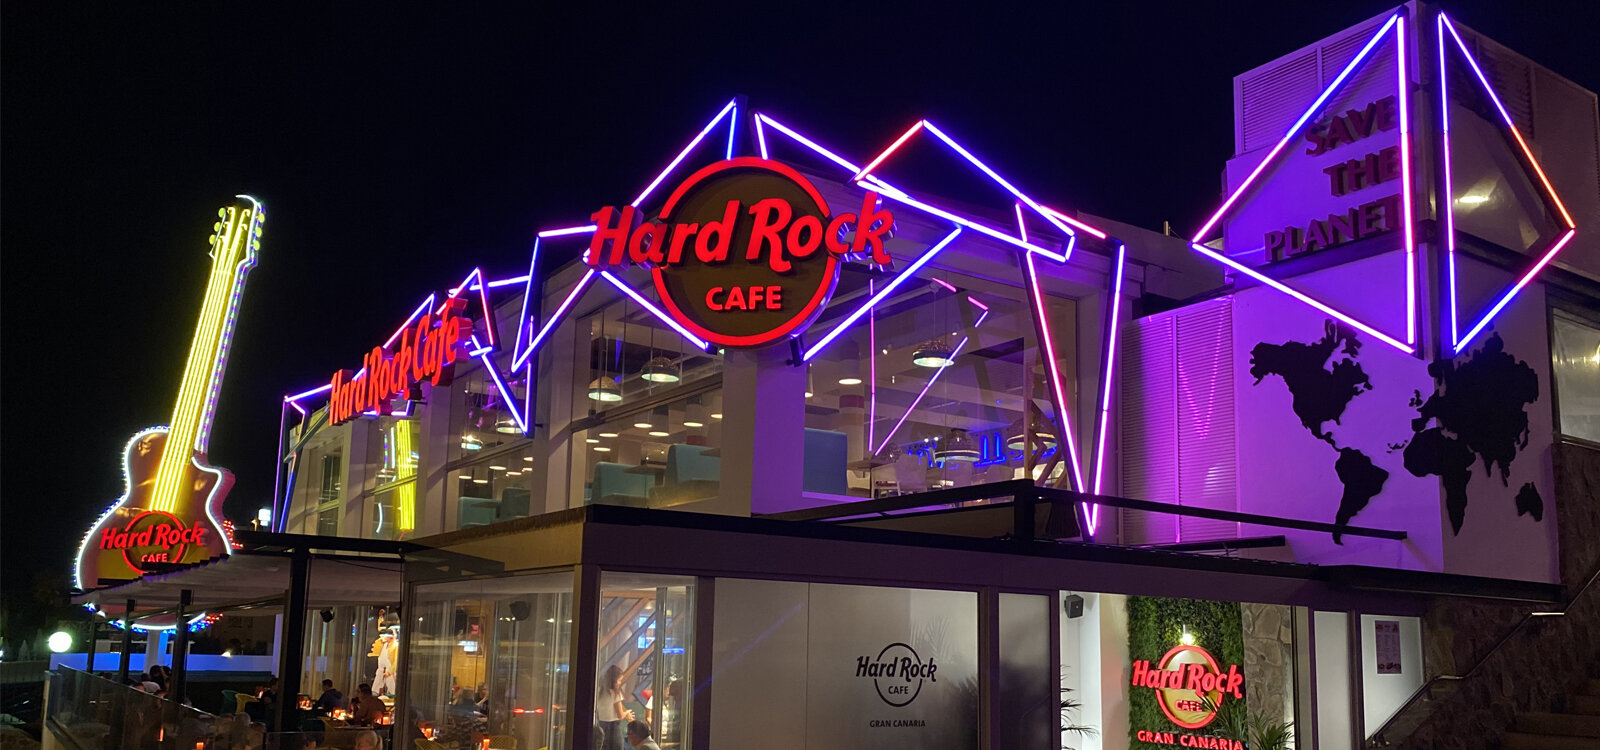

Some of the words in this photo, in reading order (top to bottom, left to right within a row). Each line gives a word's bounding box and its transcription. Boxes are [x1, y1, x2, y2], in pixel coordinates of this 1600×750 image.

[1305, 95, 1398, 157] SAVE
[1323, 145, 1401, 197] THE
[588, 200, 740, 265] Hard
[746, 191, 894, 273] Rock
[1264, 193, 1404, 263] PLANET
[705, 286, 782, 310] CAFE
[329, 353, 369, 426] Hard
[368, 327, 412, 415] Rock
[413, 298, 459, 386] Cafe
[100, 524, 153, 549] Hard
[156, 521, 204, 549] Rock
[141, 553, 168, 563] CAFE
[856, 656, 898, 677] Hard
[900, 657, 937, 682] Rock
[1132, 660, 1186, 689] Hard
[1187, 663, 1243, 699] Rock
[888, 686, 909, 694] CAFE
[1175, 700, 1203, 712] CAFE
[870, 720, 891, 728] GRAN
[893, 720, 926, 728] CANARIA
[1137, 730, 1174, 744] GRAN
[1180, 735, 1244, 750] CANARIA
